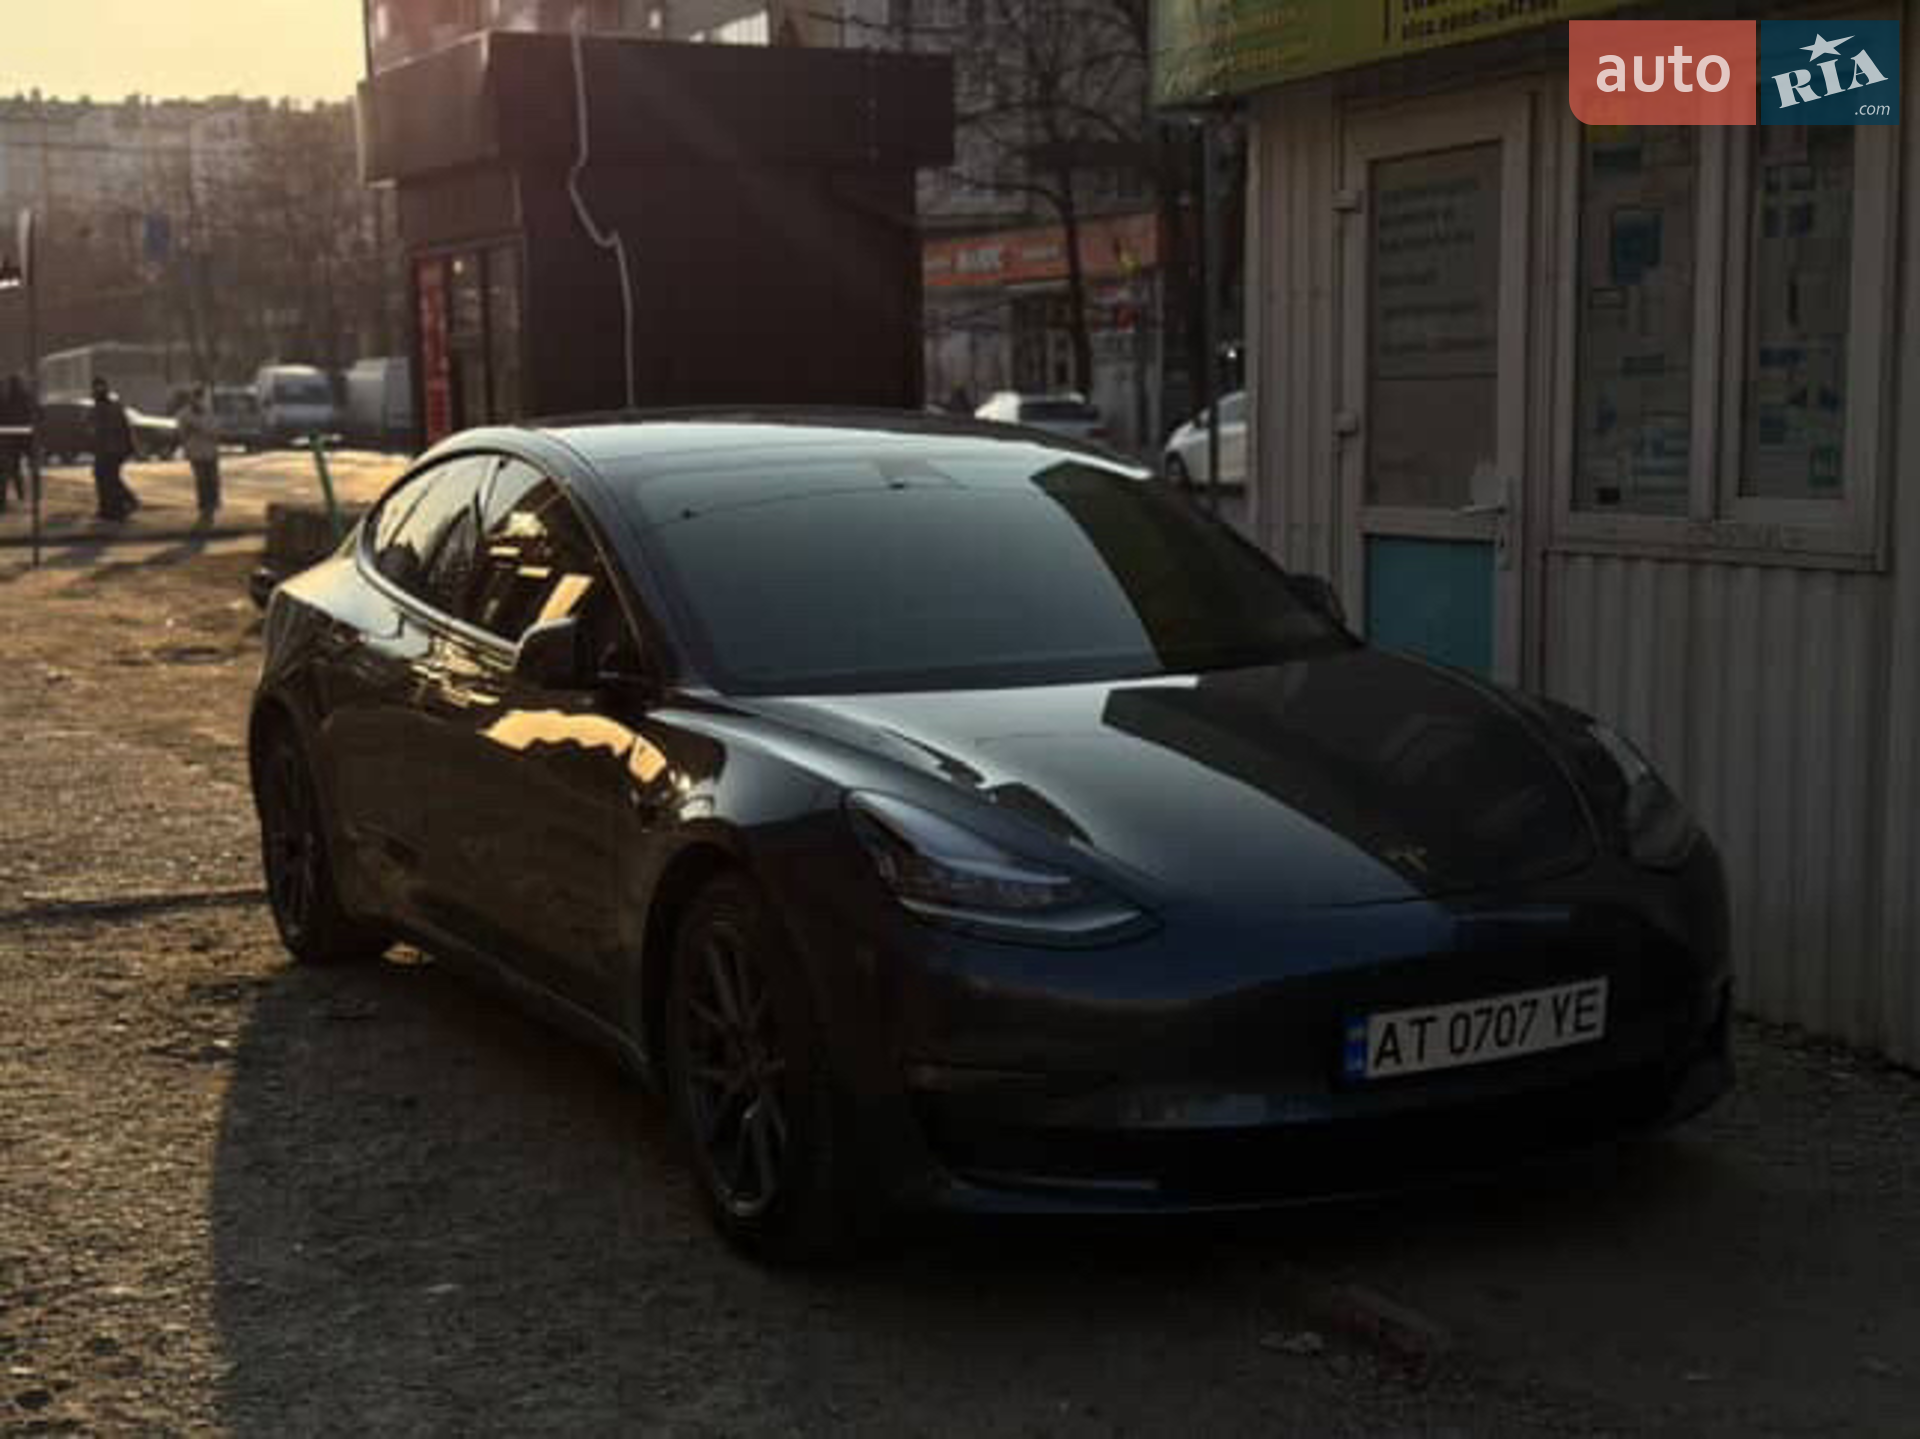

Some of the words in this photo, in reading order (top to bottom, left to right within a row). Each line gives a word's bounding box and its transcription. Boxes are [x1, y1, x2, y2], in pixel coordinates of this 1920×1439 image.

[1374, 1016, 1437, 1068] AT
[1450, 1000, 1537, 1055] 0707
[1552, 986, 1599, 1037] YE
